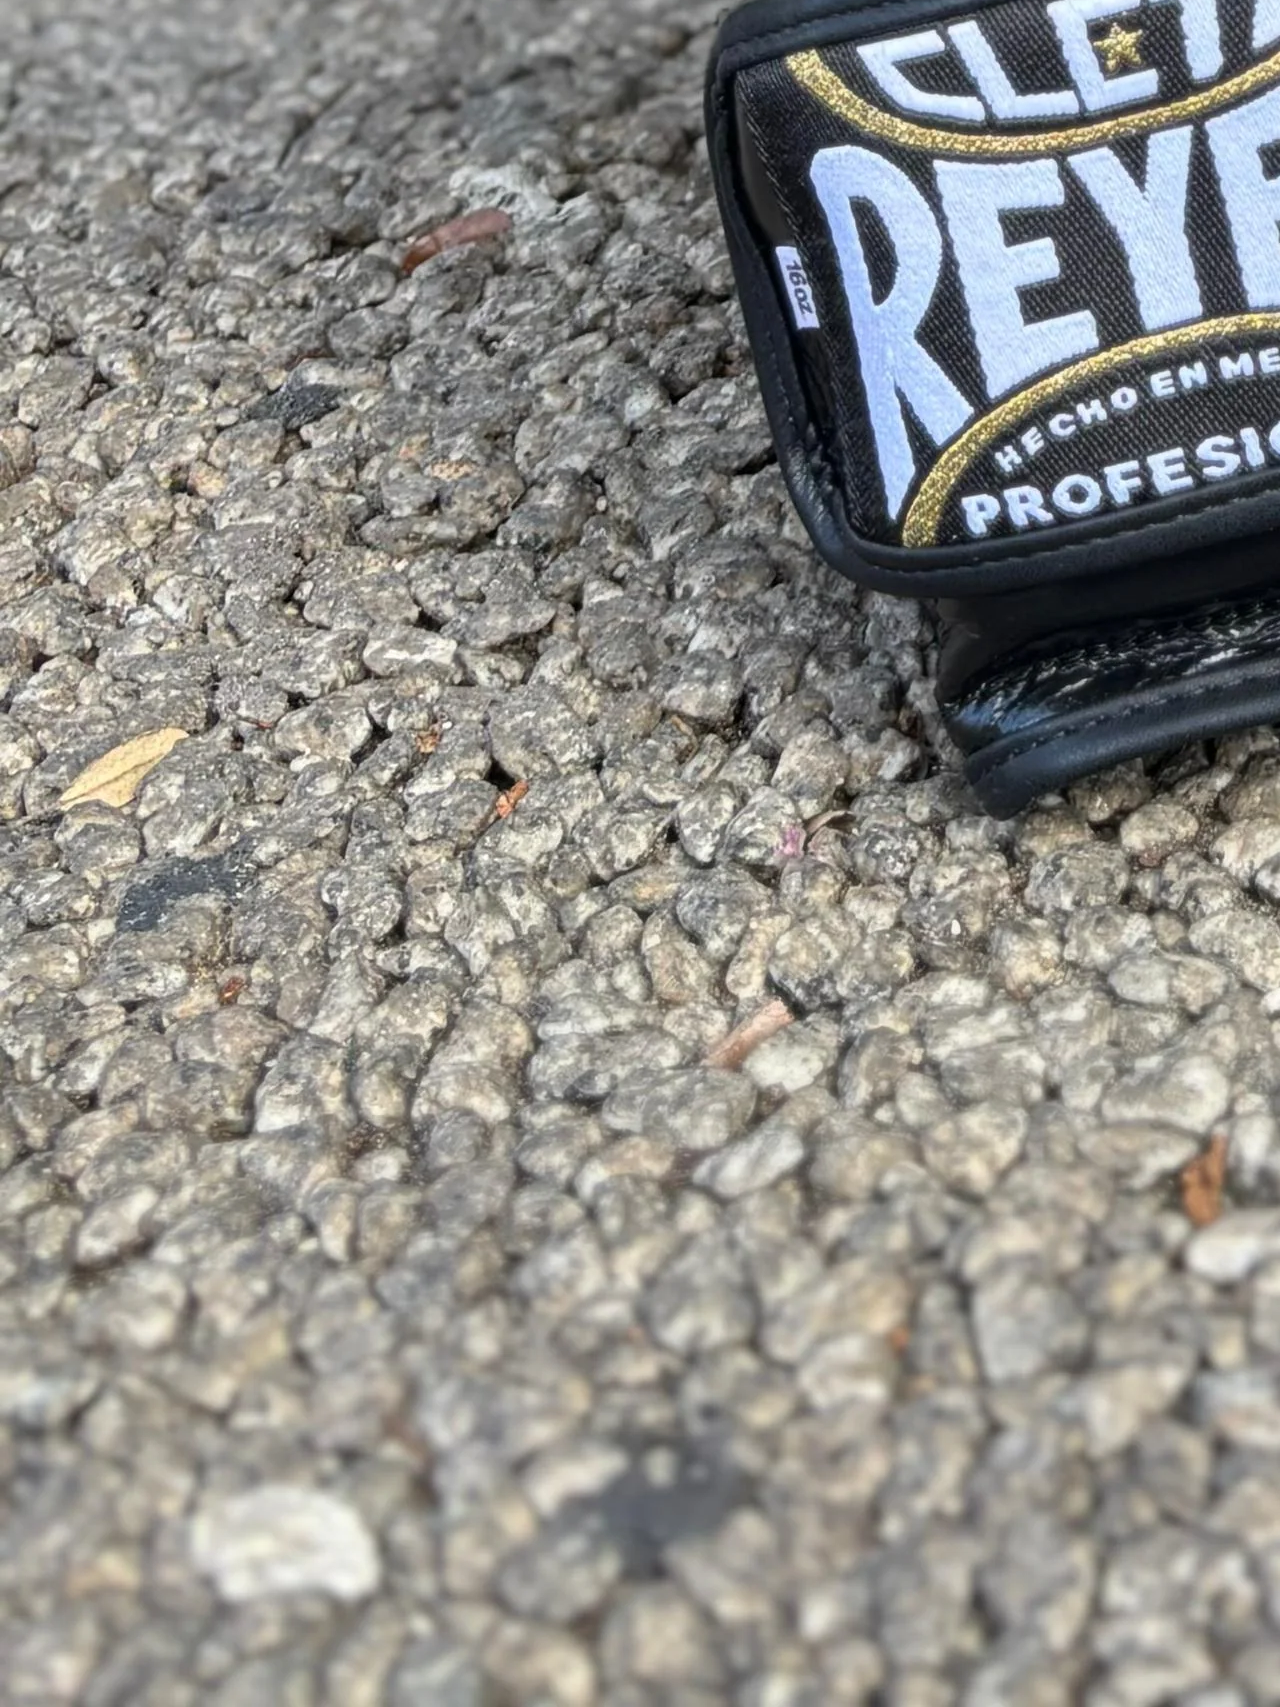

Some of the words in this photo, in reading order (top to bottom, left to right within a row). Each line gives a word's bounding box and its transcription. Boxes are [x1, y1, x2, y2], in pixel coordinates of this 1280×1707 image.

[785, 260, 813, 315] 16oz
[994, 388, 1139, 473] HECHO
[1151, 361, 1208, 399] EN
